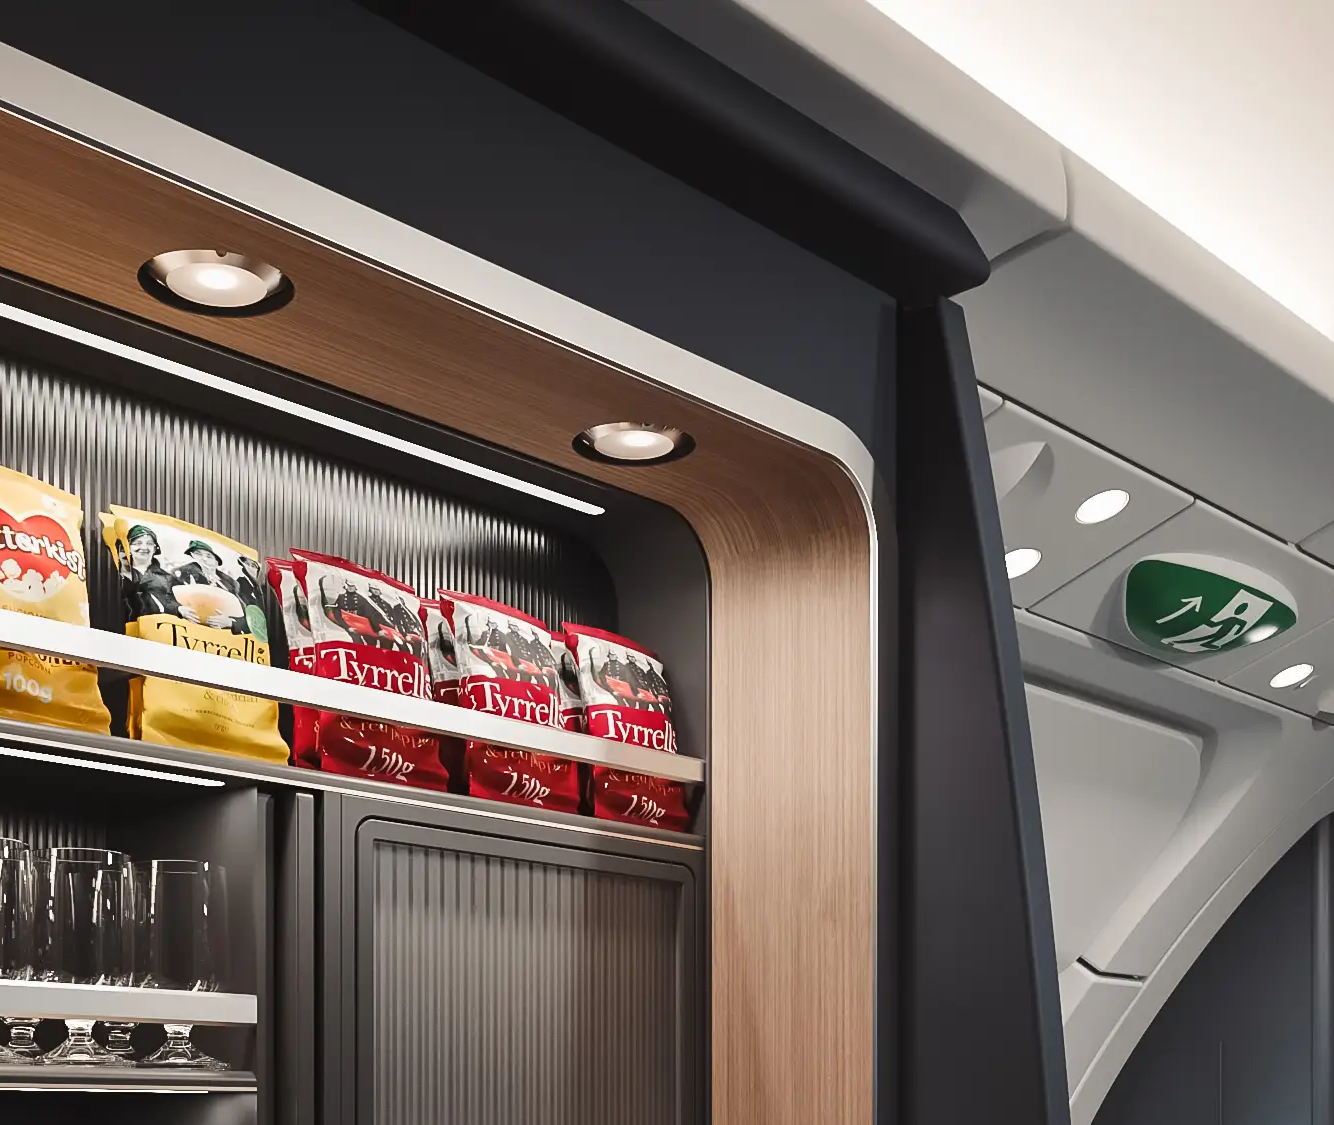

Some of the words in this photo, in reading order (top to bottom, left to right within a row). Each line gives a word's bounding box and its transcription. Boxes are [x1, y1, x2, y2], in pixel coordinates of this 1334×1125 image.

[2, 671, 53, 704] 100g
[320, 647, 433, 701] Tyrrells
[467, 681, 566, 730] Tyrrells
[359, 745, 416, 782] 150g
